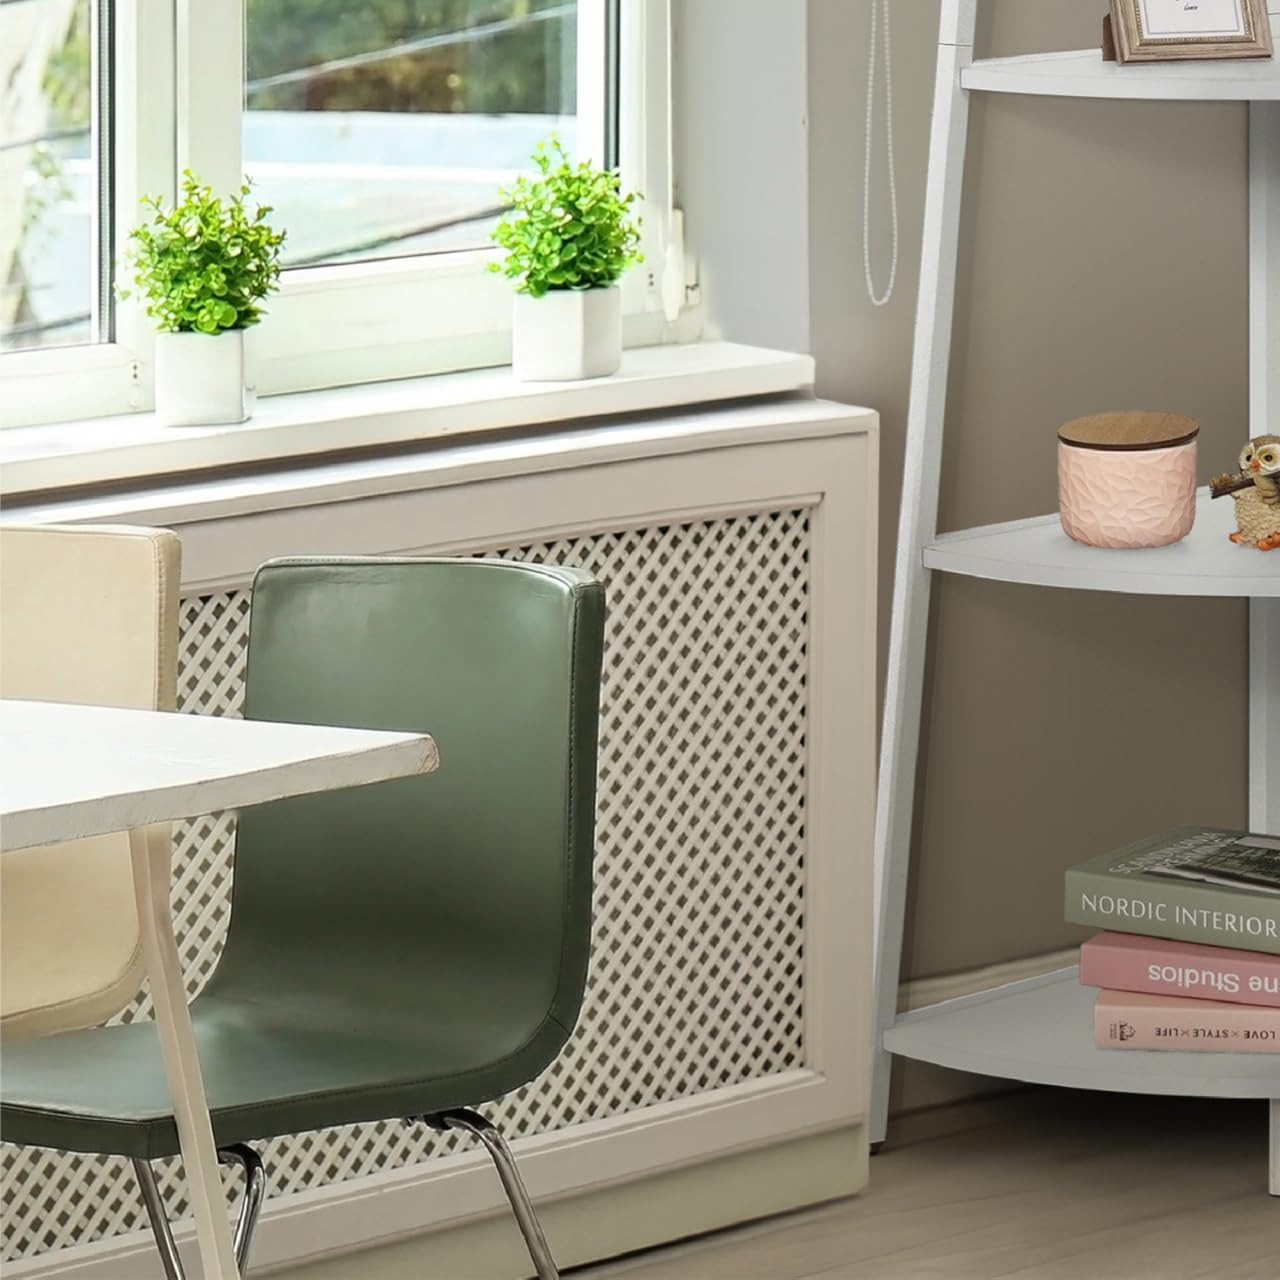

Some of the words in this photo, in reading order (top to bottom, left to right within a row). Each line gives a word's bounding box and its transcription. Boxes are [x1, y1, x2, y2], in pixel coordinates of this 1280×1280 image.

[1081, 892, 1167, 922] NORDIC
[1148, 963, 1240, 992] Studios
[1154, 1027, 1179, 1037] LIFE
[1192, 1028, 1229, 1039] STYLE
[1243, 1030, 1276, 1040] LOVE
